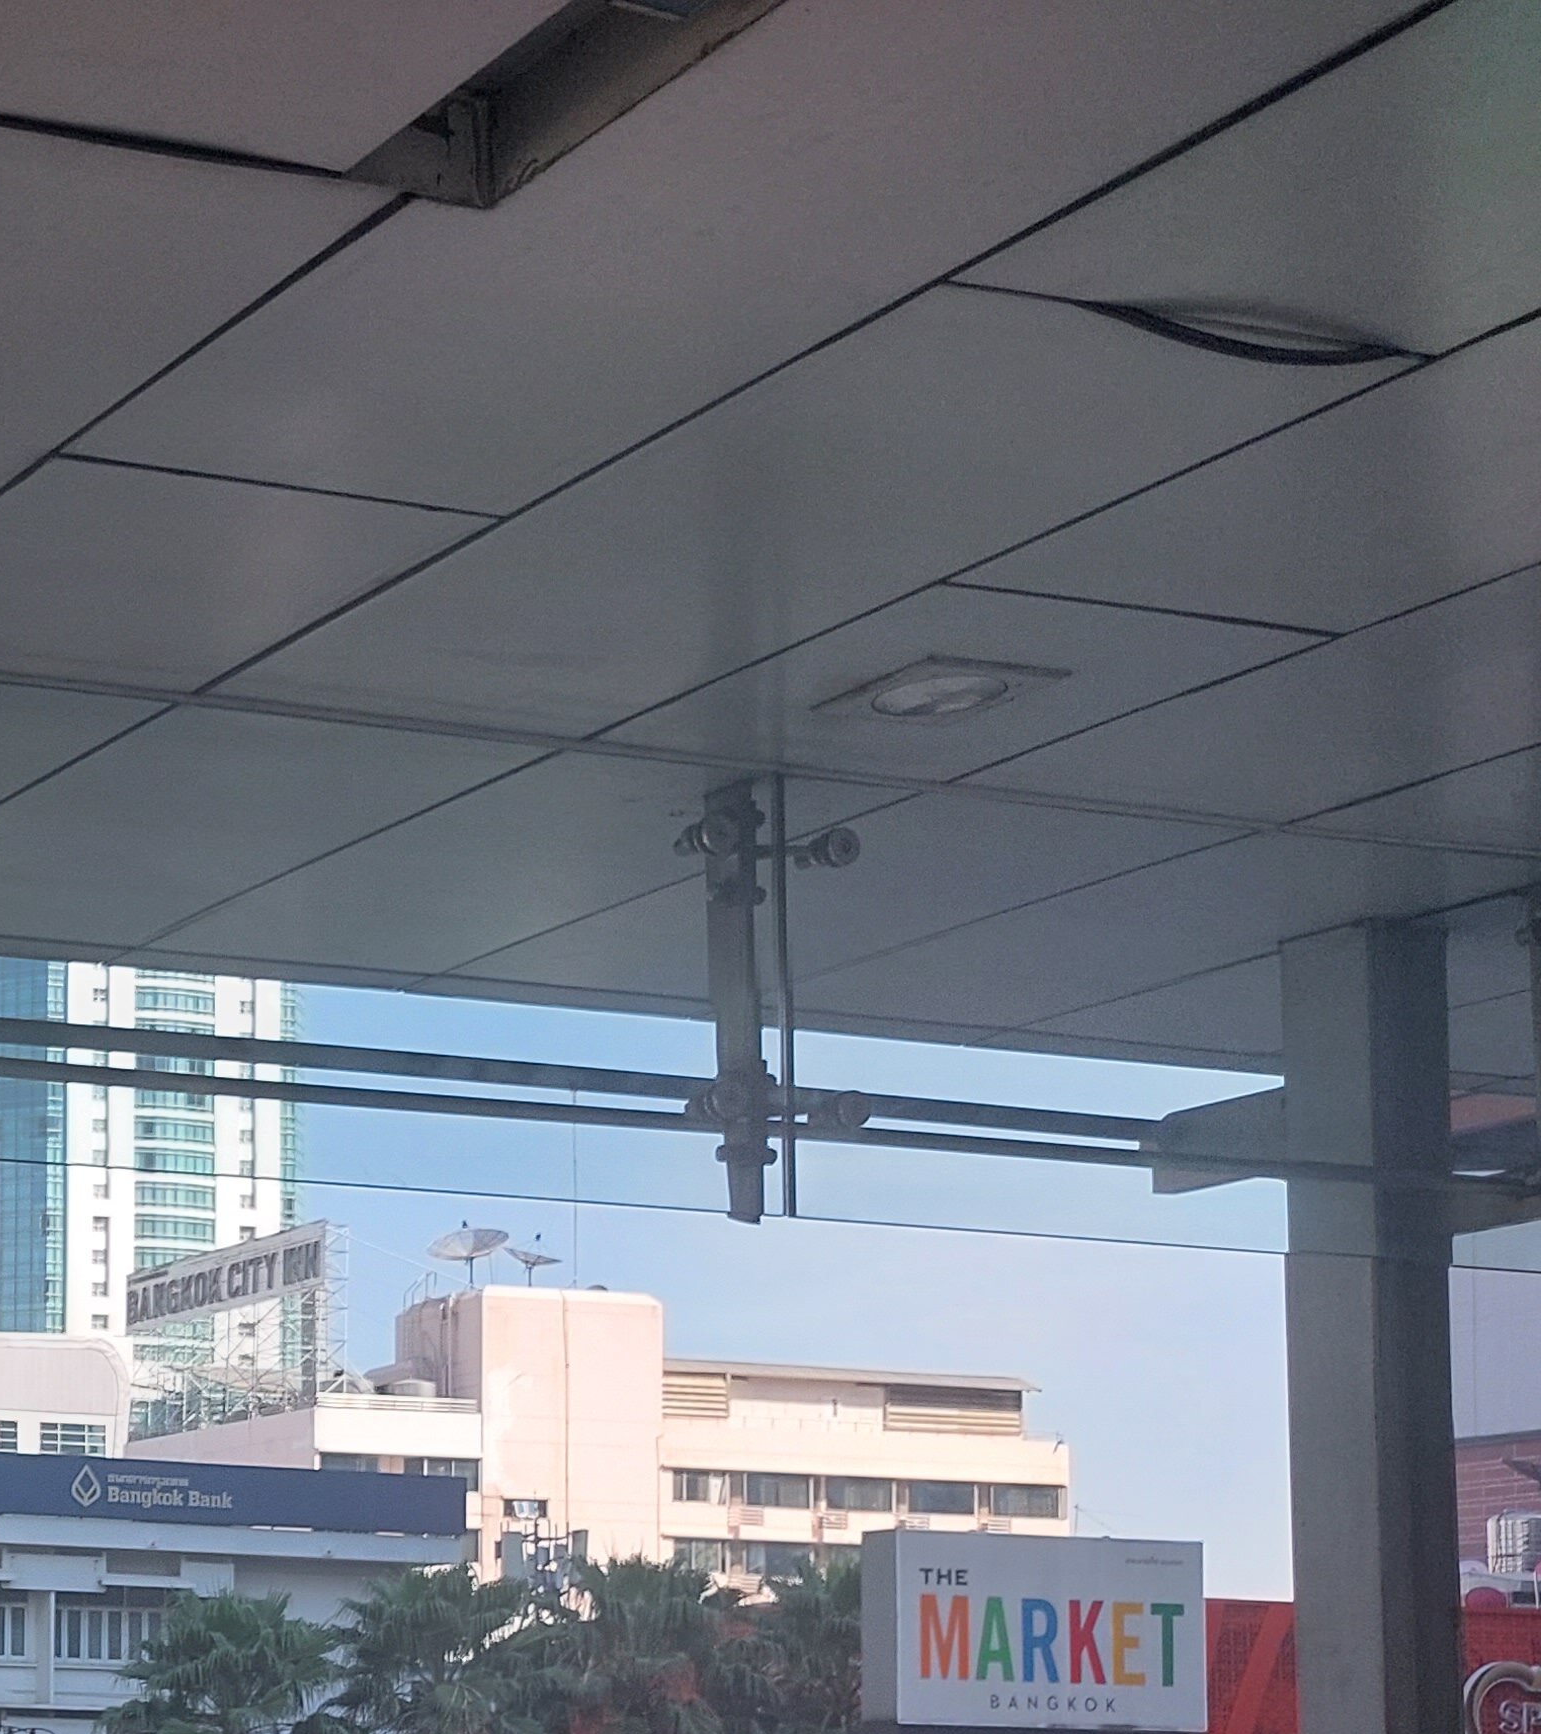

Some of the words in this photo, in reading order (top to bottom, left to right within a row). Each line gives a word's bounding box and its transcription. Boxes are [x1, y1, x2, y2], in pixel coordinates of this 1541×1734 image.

[127, 1266, 223, 1327] BANGKOK
[228, 1251, 279, 1299] CITY
[107, 1485, 184, 1508] Bangkok
[188, 1490, 233, 1509] Bank
[918, 1567, 970, 1587] THE
[919, 1593, 1186, 1688] MARKET
[989, 1694, 1118, 1713] BANGKOK
